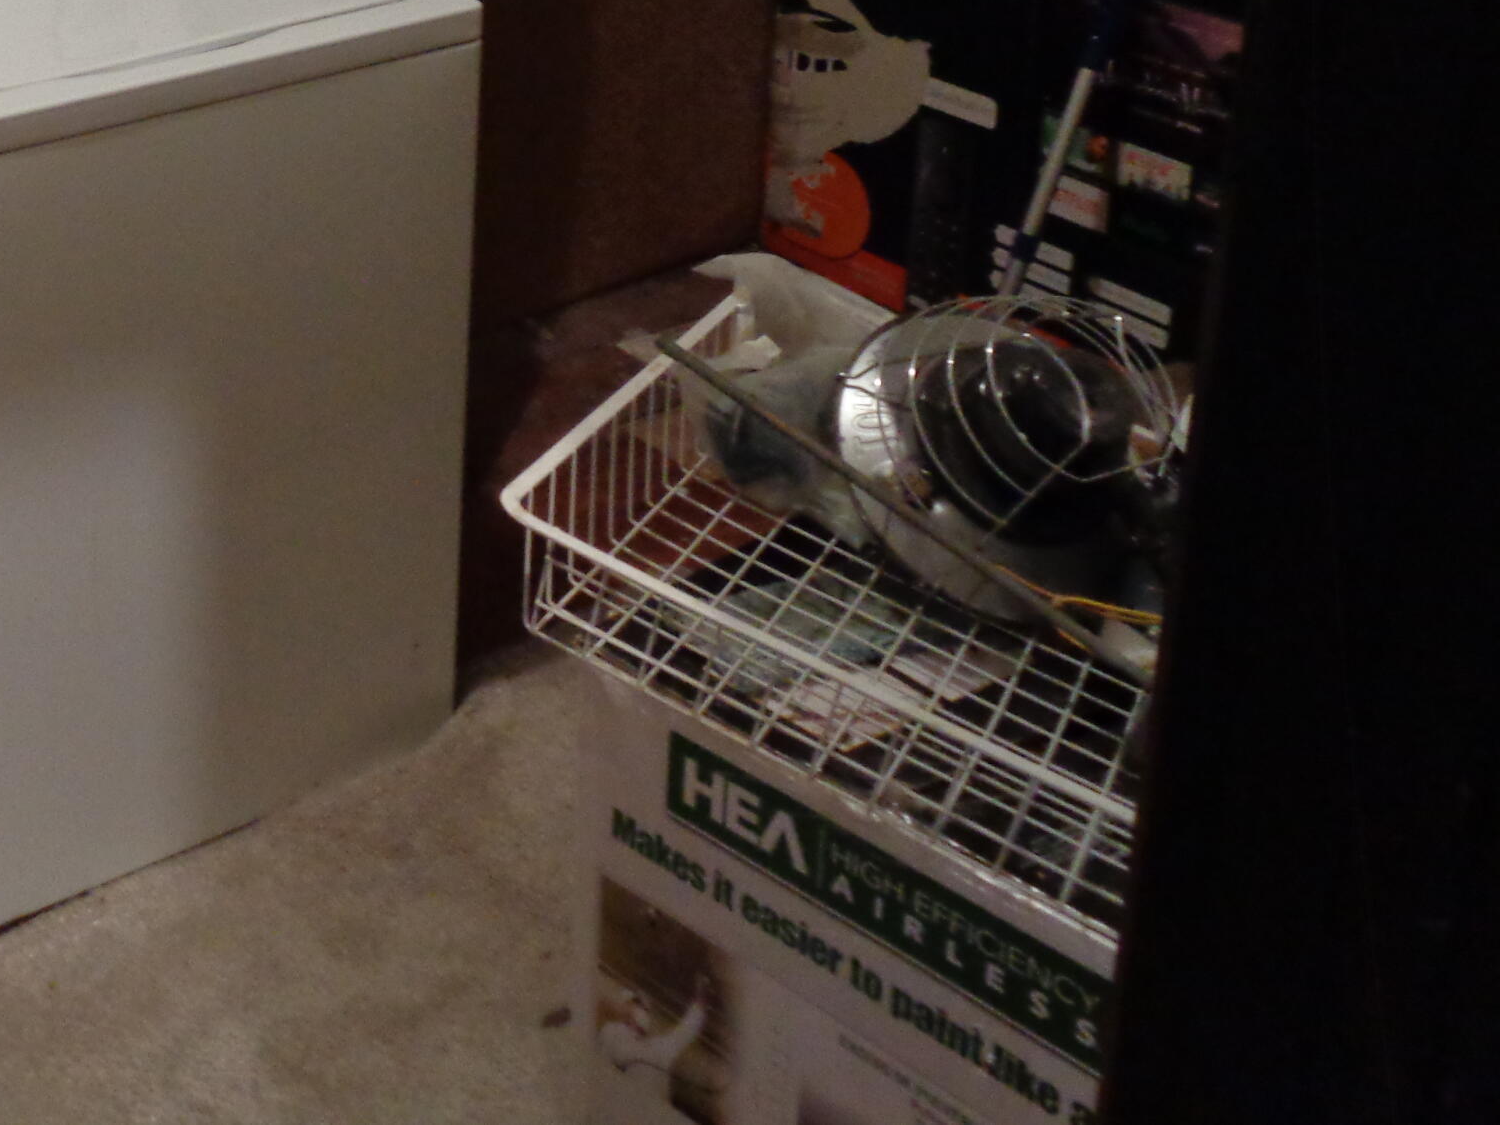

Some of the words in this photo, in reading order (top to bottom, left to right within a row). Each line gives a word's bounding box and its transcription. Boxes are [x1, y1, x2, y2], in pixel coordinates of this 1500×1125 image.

[612, 806, 707, 892] Makes
[713, 867, 733, 912] it
[741, 892, 843, 975] easier
[850, 955, 880, 1000] to
[830, 843, 906, 903] HIGH
[913, 890, 1100, 1011] EFFICIENCY
[830, 874, 1099, 1049] AIRLESS
